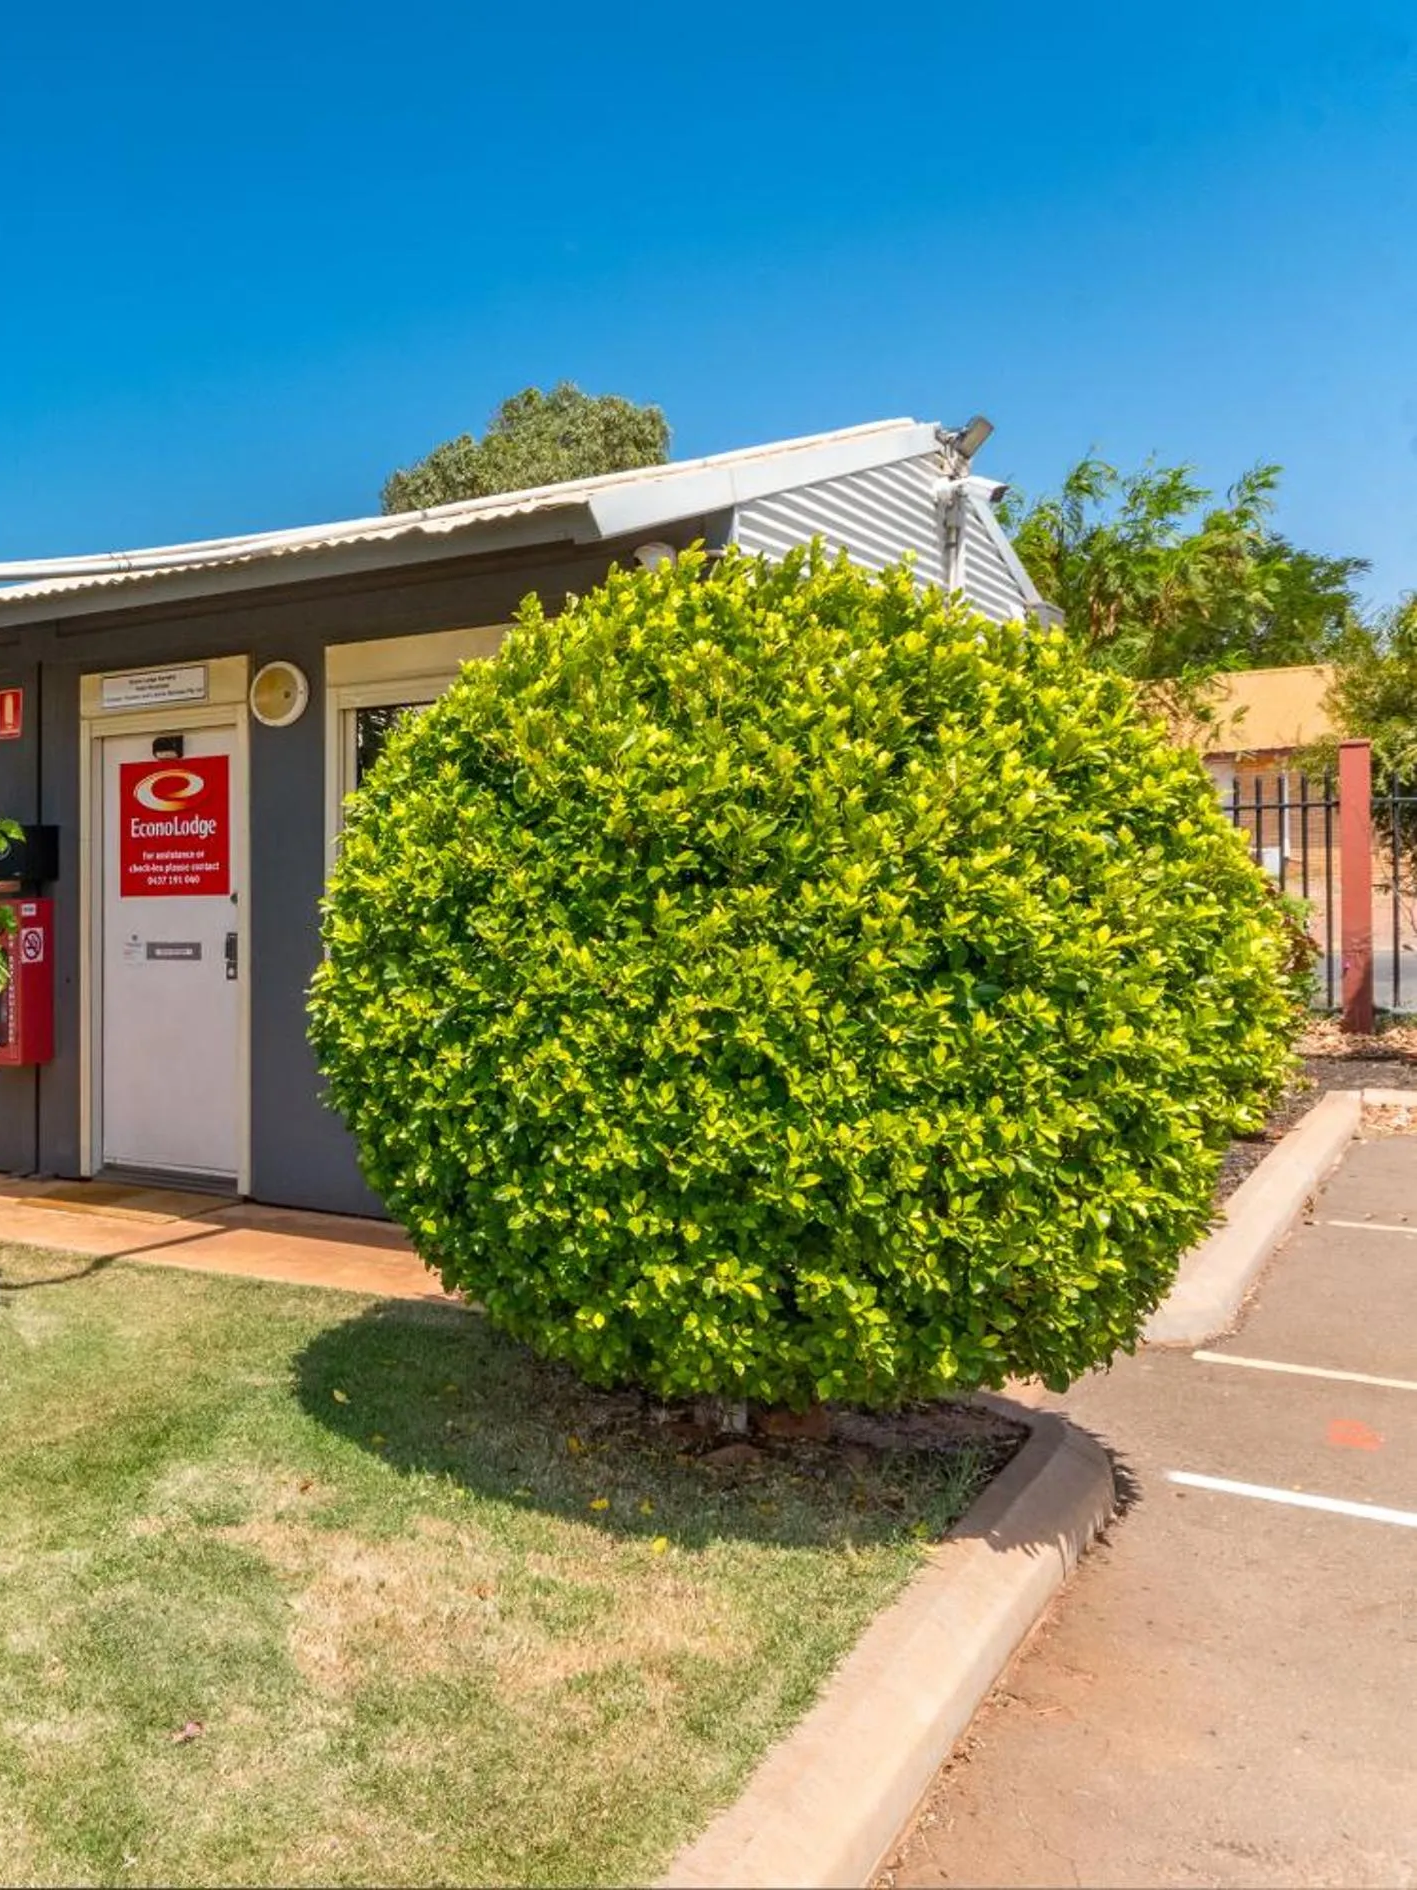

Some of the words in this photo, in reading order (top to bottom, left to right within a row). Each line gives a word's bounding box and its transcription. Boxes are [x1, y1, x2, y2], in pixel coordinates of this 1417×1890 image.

[131, 814, 217, 839] EconoLodge
[165, 862, 190, 874] please
[191, 861, 220, 872] contact
